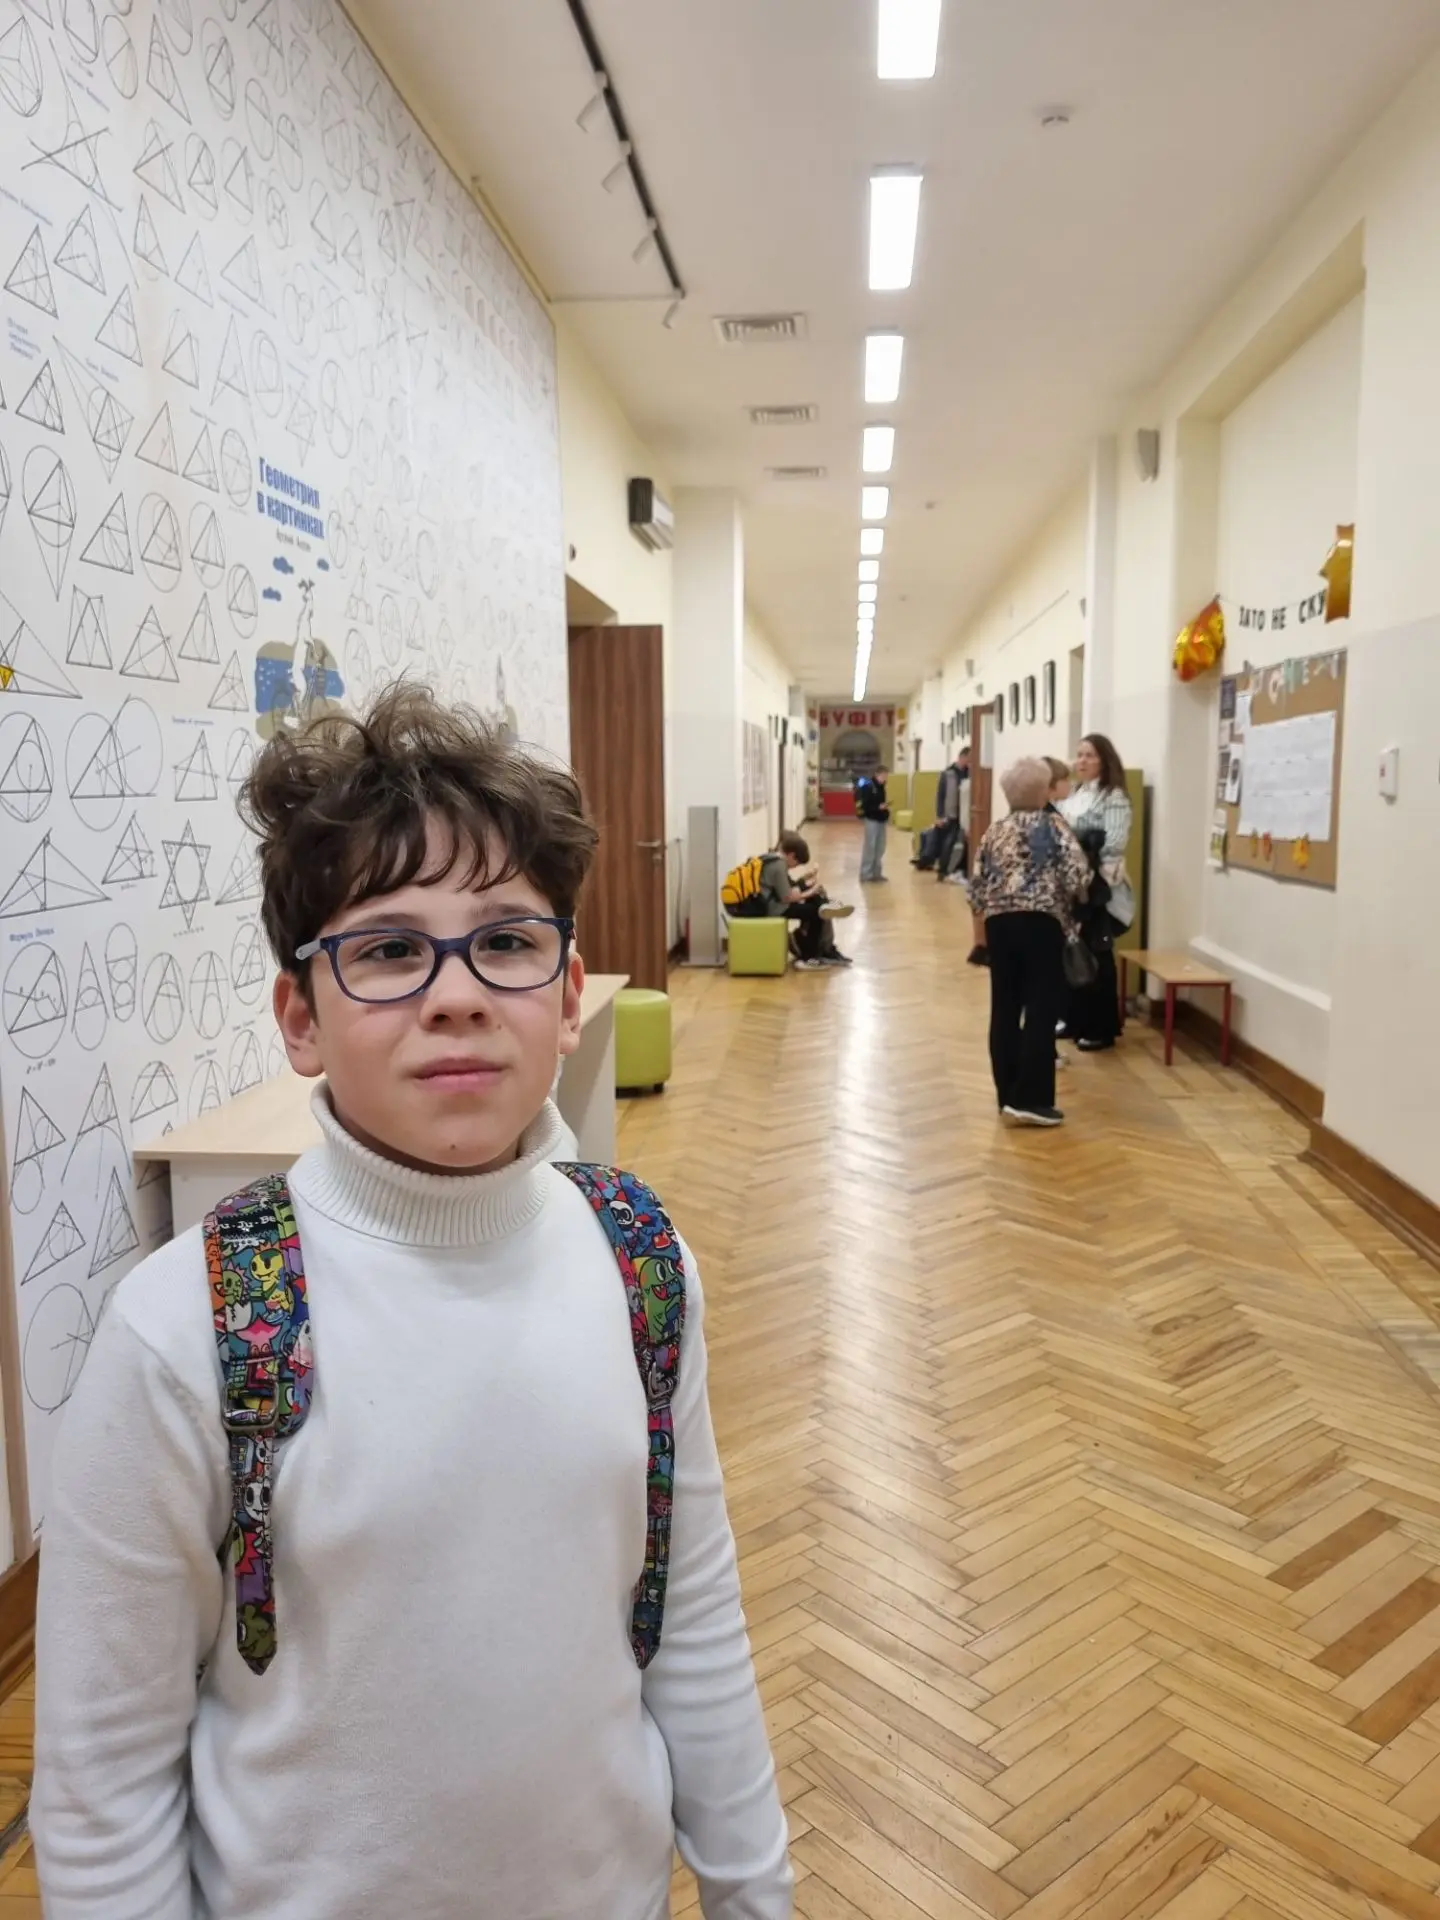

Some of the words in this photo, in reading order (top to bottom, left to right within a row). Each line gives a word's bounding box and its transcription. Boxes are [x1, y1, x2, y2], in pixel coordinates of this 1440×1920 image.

[259, 456, 320, 510] Геометрия
[257, 490, 265, 513] в
[266, 496, 324, 540] картинках
[1271, 606, 1286, 631] НЕ
[819, 709, 895, 729] БУФЕТ
